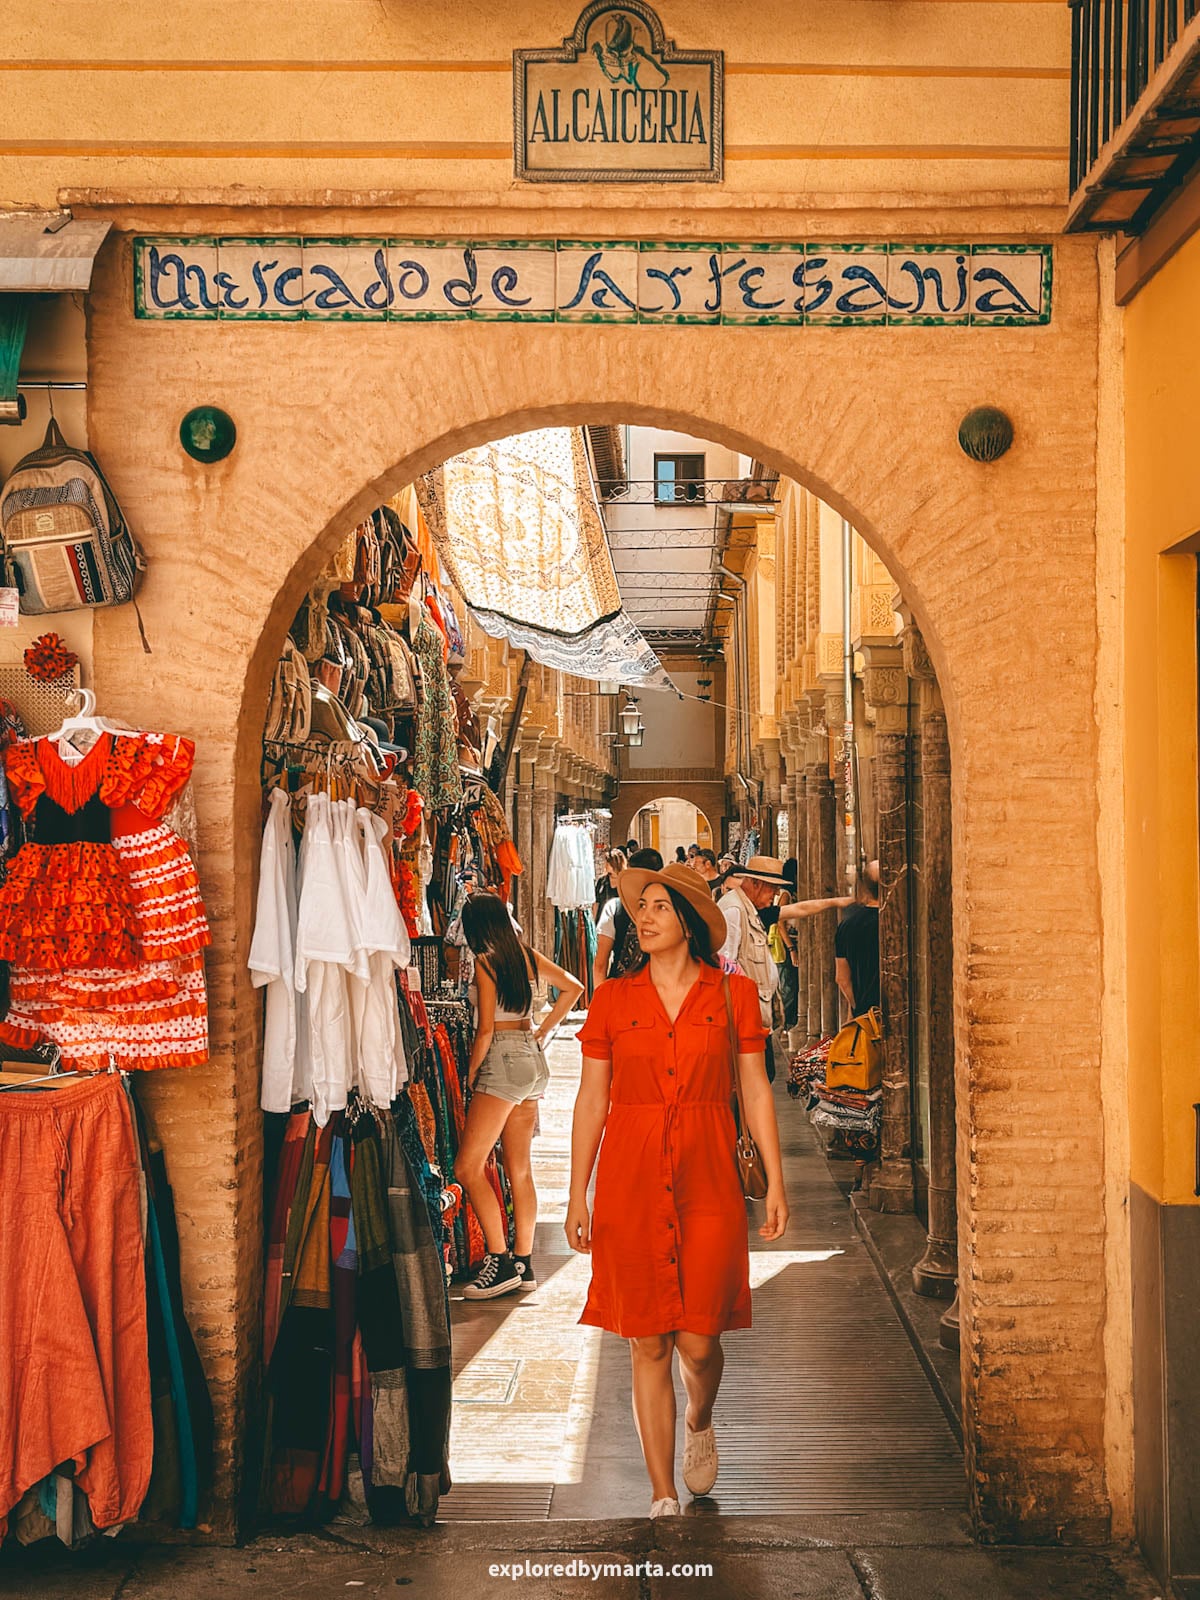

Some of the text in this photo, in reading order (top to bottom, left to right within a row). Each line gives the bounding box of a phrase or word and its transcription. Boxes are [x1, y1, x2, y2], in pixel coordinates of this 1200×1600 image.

[528, 88, 707, 144] ALCAICERIA
[149, 245, 430, 310] Mercado
[443, 247, 532, 307] de
